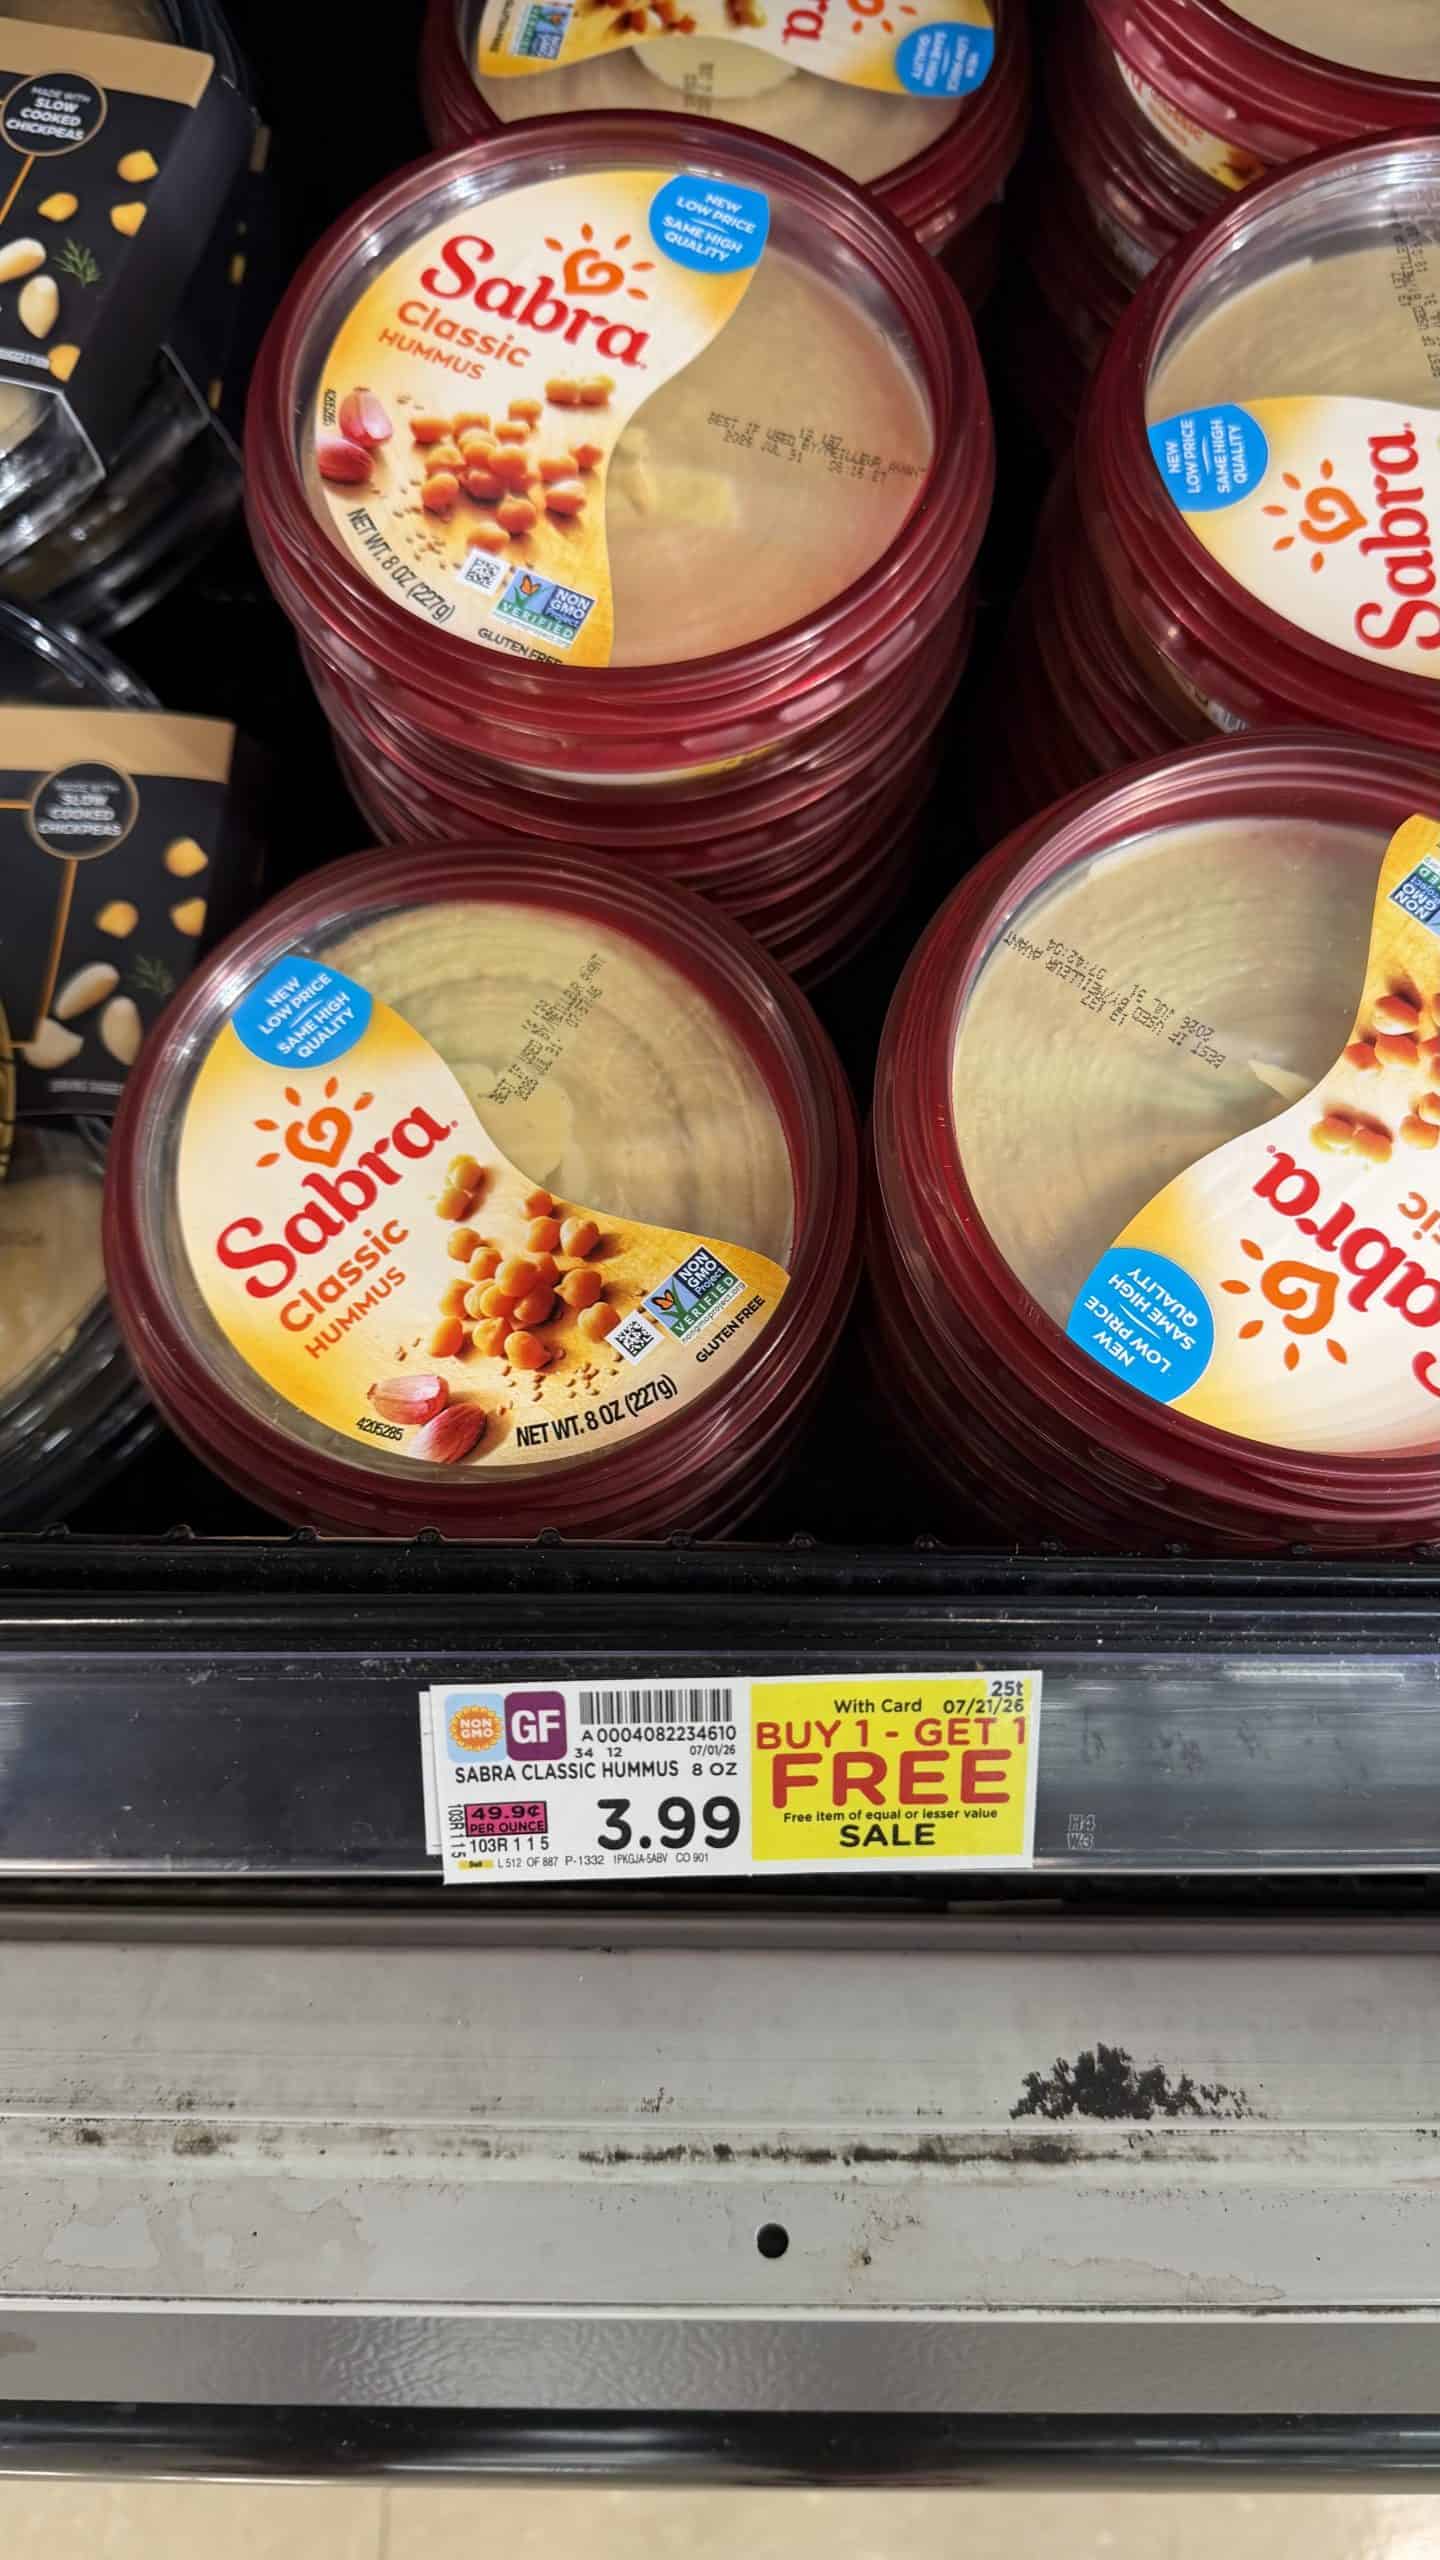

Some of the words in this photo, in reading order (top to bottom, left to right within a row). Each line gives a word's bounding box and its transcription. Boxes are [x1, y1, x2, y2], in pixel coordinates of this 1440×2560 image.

[20, 107, 81, 127] COOKED
[34, 97, 79, 113] SLOW
[5, 118, 84, 141] CHICKPEAS
[676, 196, 712, 216] LOW
[711, 210, 756, 234] PRICE
[705, 193, 742, 213] NEW
[663, 215, 705, 240] SAME
[704, 232, 743, 253] HIGH
[664, 231, 730, 262] QUALITY
[420, 235, 650, 367] Sabra
[397, 301, 531, 367] Classic
[378, 327, 485, 380] HUMMUS
[1180, 418, 1197, 460] PRICE
[1210, 419, 1226, 455] HIGH
[1165, 440, 1181, 474] NEW
[1227, 424, 1248, 484] QUALITY
[1184, 461, 1201, 494] LOW
[1214, 455, 1231, 494] SAME
[1354, 429, 1440, 651] Sabra
[347, 507, 377, 535] NET
[365, 532, 392, 561] WT.
[381, 555, 400, 571] 8
[391, 565, 417, 588] OZ
[406, 582, 456, 624] (227g)
[551, 600, 586, 620] GMO
[555, 589, 592, 611] NON
[499, 602, 575, 639] VERIFIED
[478, 627, 531, 660] GLUTEN
[1395, 890, 1432, 921] NON
[1402, 882, 1438, 911] GMO
[1002, 931, 1043, 962] AVANT
[258, 1004, 293, 1035] LOW
[290, 972, 332, 1009] PRICE
[265, 976, 300, 1008] NEW
[1127, 983, 1147, 1003] 31
[277, 1018, 318, 1054] SAME
[313, 991, 351, 1025] HIGH
[1130, 1006, 1165, 1034] USED
[1149, 998, 1174, 1020] JUL
[297, 1007, 355, 1058] QUALITY
[1167, 1027, 1186, 1045] IF
[1180, 1015, 1213, 1042] 2026
[1190, 1041, 1225, 1068] BEST
[217, 1106, 451, 1298] Sabra
[280, 1218, 409, 1332] Classic
[678, 1251, 709, 1281] NON
[687, 1260, 717, 1288] GMO
[1252, 1152, 1440, 1398] abra
[675, 1276, 735, 1333] VERIFIED
[1107, 1273, 1151, 1313] HIGH
[1127, 1267, 1198, 1328] QUALITY
[304, 1266, 407, 1360] HUMMUS
[695, 1321, 740, 1363] GLUTEN
[735, 1295, 766, 1326] FREE
[1084, 1295, 1134, 1340] PRICE
[1147, 1307, 1197, 1351] SAME
[1092, 1331, 1136, 1368] NEW
[1130, 1337, 1172, 1373] LOW
[516, 1422, 550, 1448] NET
[551, 1415, 585, 1441] WT.
[584, 1411, 599, 1431] 8
[600, 1401, 625, 1425] OZ
[624, 1373, 679, 1417] (227g)
[991, 1680, 1024, 1698] 25t
[460, 1718, 492, 1729] NON
[834, 1699, 877, 1714] With
[881, 1698, 922, 1713] Card
[943, 1698, 1025, 1716] 07/21/26
[461, 1728, 494, 1739] GMO
[511, 1709, 561, 1744] GF
[582, 1731, 594, 1742] A
[598, 1726, 737, 1743] 0004082234610
[756, 1719, 842, 1750] BUY
[855, 1719, 868, 1747] 1
[885, 1730, 899, 1739] -
[914, 1717, 997, 1747] GET
[1013, 1717, 1026, 1745] 1
[575, 1748, 593, 1759] 34
[608, 1747, 623, 1758] 12
[689, 1744, 736, 1757] 07/01/26
[455, 1762, 516, 1784] SABRA
[522, 1761, 597, 1781] CLASSIC
[602, 1760, 679, 1778] HUMMUS
[692, 1763, 704, 1777] 8
[710, 1762, 738, 1776] OZ
[772, 1748, 1013, 1809] FREE
[470, 1821, 496, 1835] PER
[499, 1820, 546, 1834] OUNCE
[471, 1805, 541, 1822] 49.9¢
[597, 1796, 740, 1851] 3.99
[783, 1812, 813, 1823] Free
[849, 1809, 862, 1821] of
[865, 1809, 901, 1823] equal
[905, 1811, 920, 1820] or
[922, 1808, 960, 1820] lesser
[963, 1808, 998, 1819] value
[470, 1837, 508, 1853] 103R
[839, 1823, 936, 1848] SALE
[526, 1856, 540, 1868] OF
[564, 1854, 605, 1866] P-1332
[675, 1852, 692, 1863] CO
[692, 1851, 709, 1863] 901
